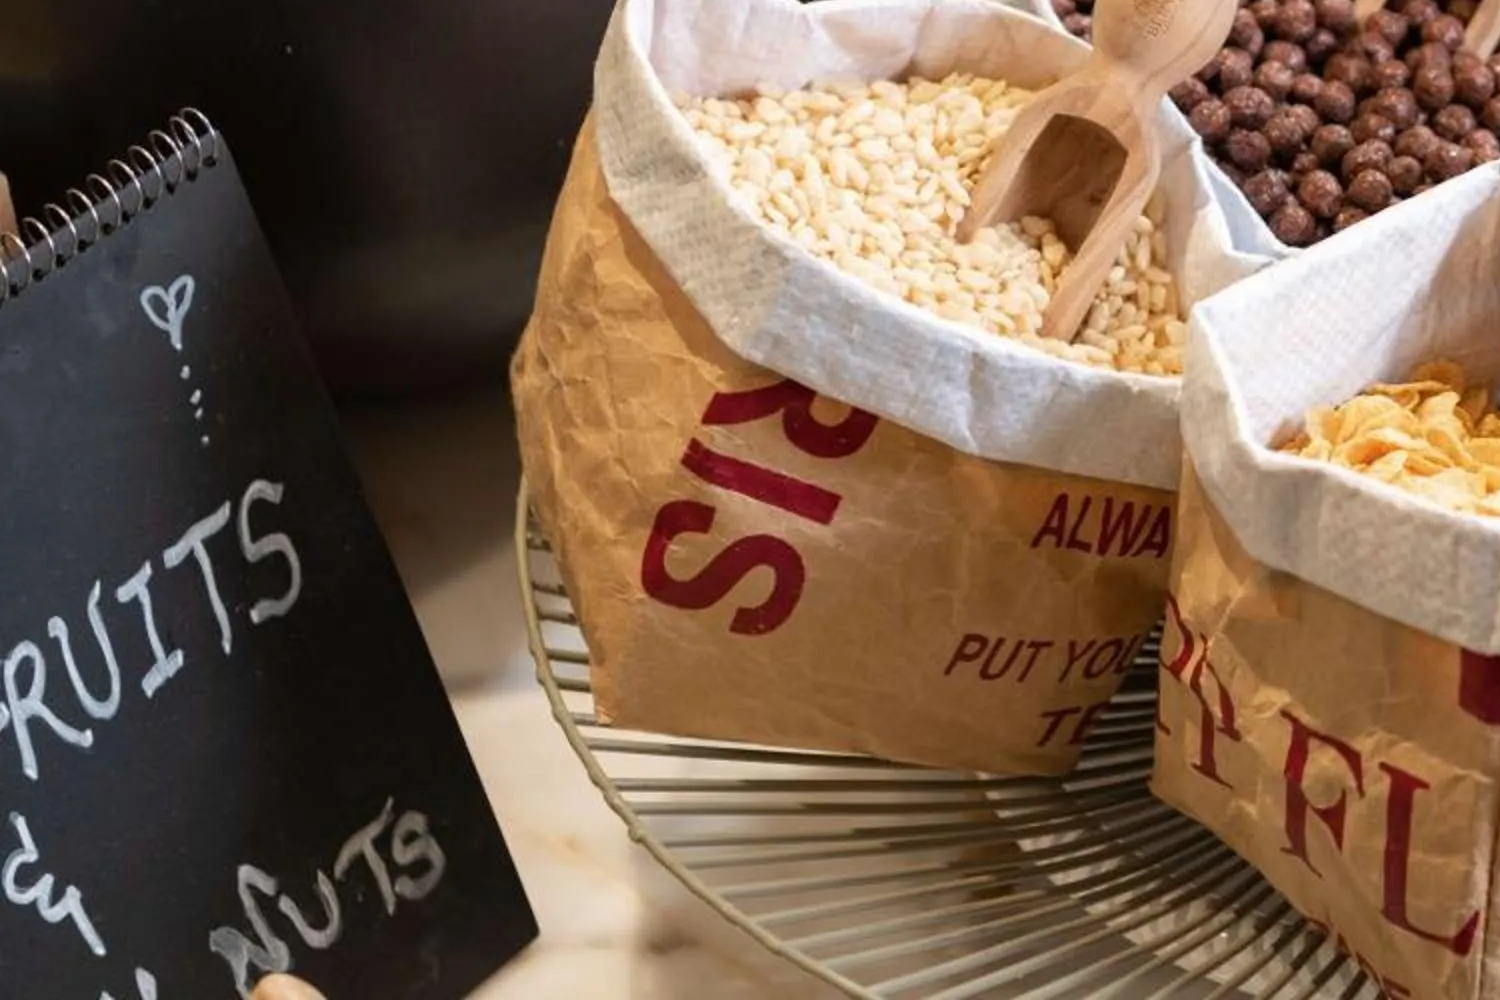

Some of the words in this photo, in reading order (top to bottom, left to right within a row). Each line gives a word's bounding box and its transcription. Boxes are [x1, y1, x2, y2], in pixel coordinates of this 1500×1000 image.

[1031, 492, 1171, 558] ALWA
[0, 479, 301, 780] RUITS
[943, 633, 1054, 683] PUT
[209, 796, 446, 1000] NUTS
